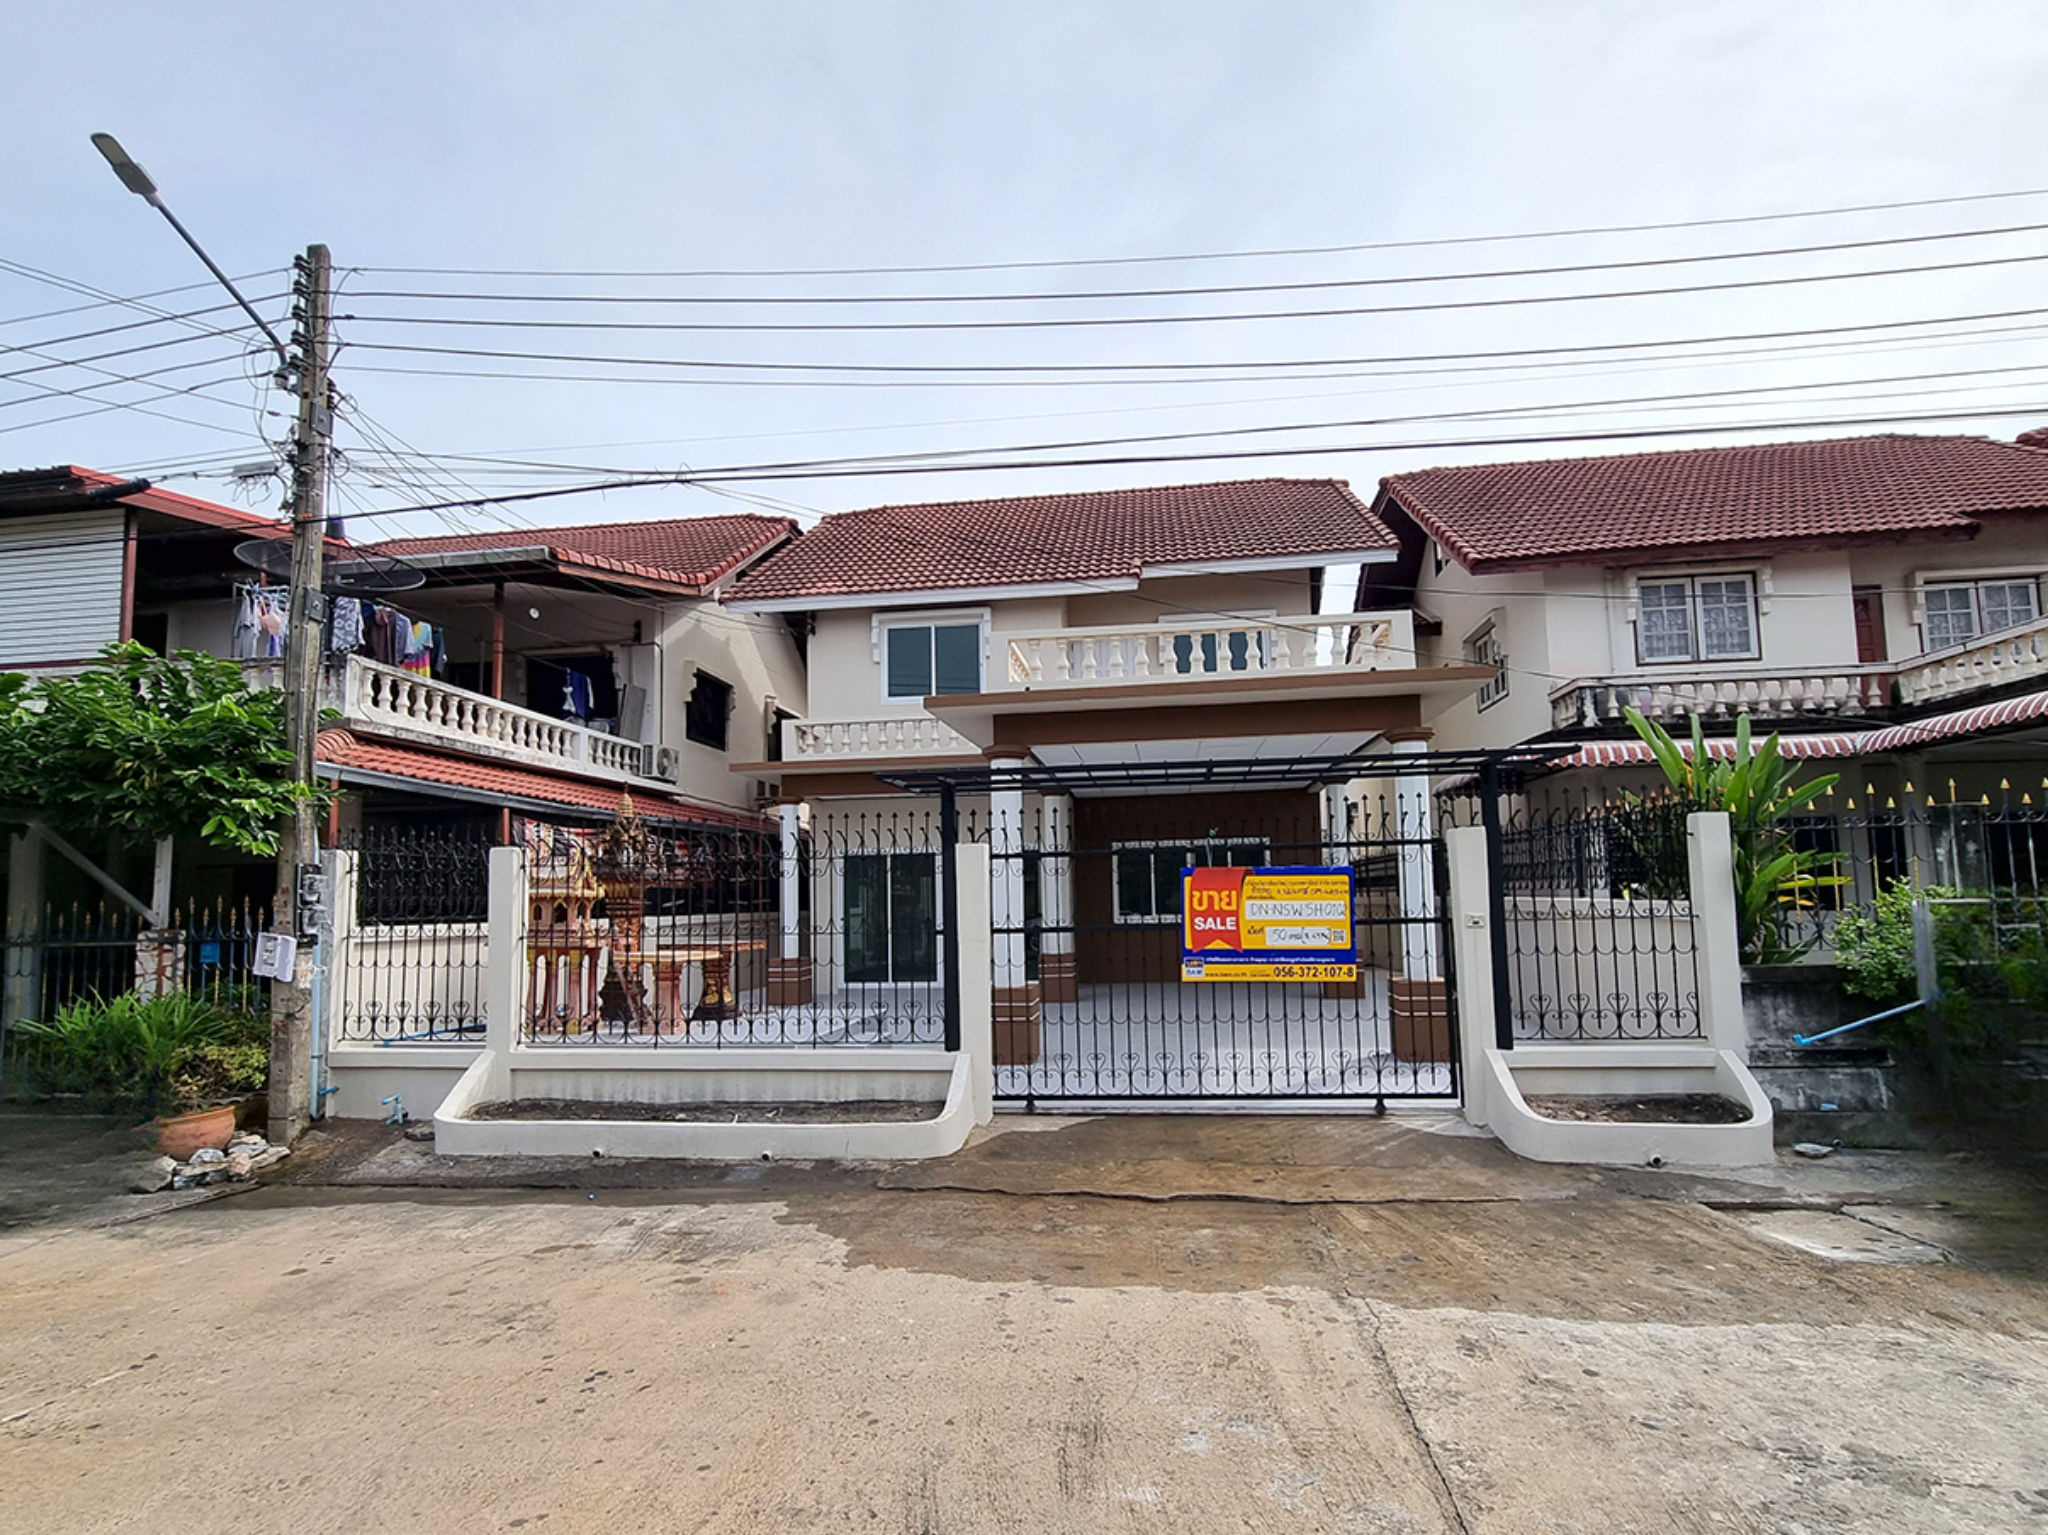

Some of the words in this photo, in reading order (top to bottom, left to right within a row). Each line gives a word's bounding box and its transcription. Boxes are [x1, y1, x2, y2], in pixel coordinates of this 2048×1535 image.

[1192, 890, 1237, 911] ขาย
[1194, 916, 1237, 930] SALE
[1273, 964, 1354, 978] 056-372-107-8
